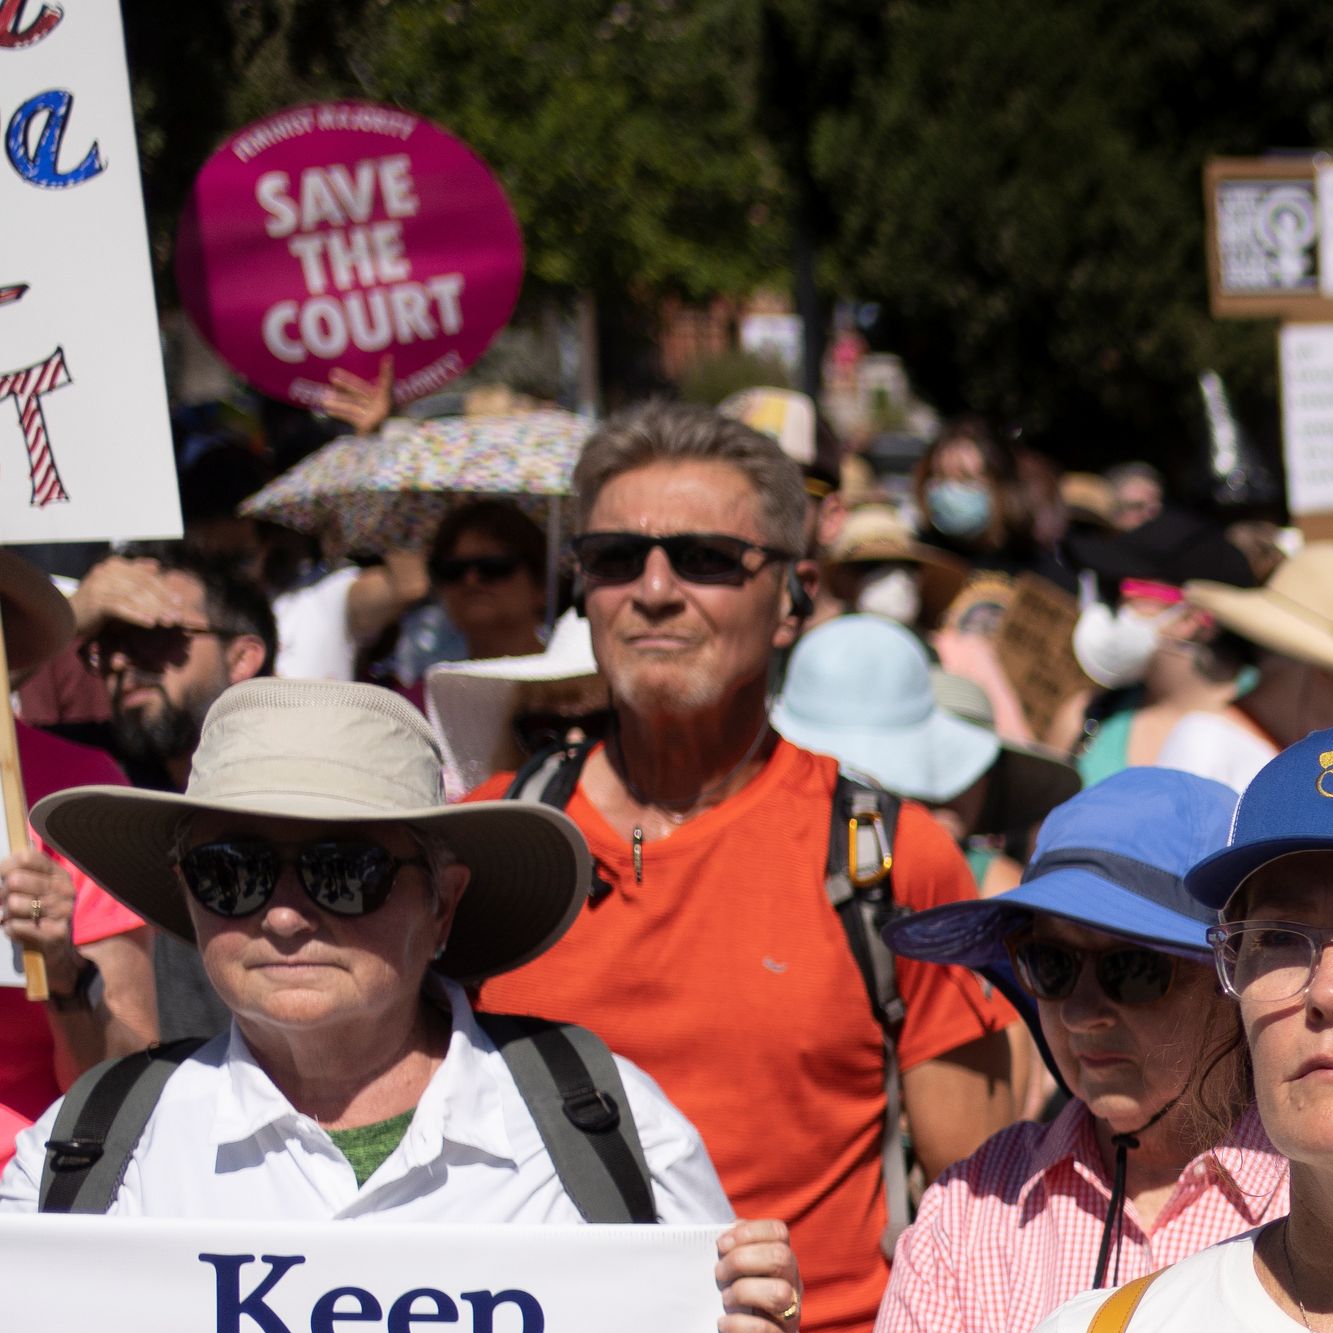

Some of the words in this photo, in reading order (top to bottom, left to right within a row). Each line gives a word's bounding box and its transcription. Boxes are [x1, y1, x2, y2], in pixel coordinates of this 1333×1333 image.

[255, 153, 420, 238] SAVE
[288, 219, 412, 296] THE
[261, 272, 466, 364] COURT
